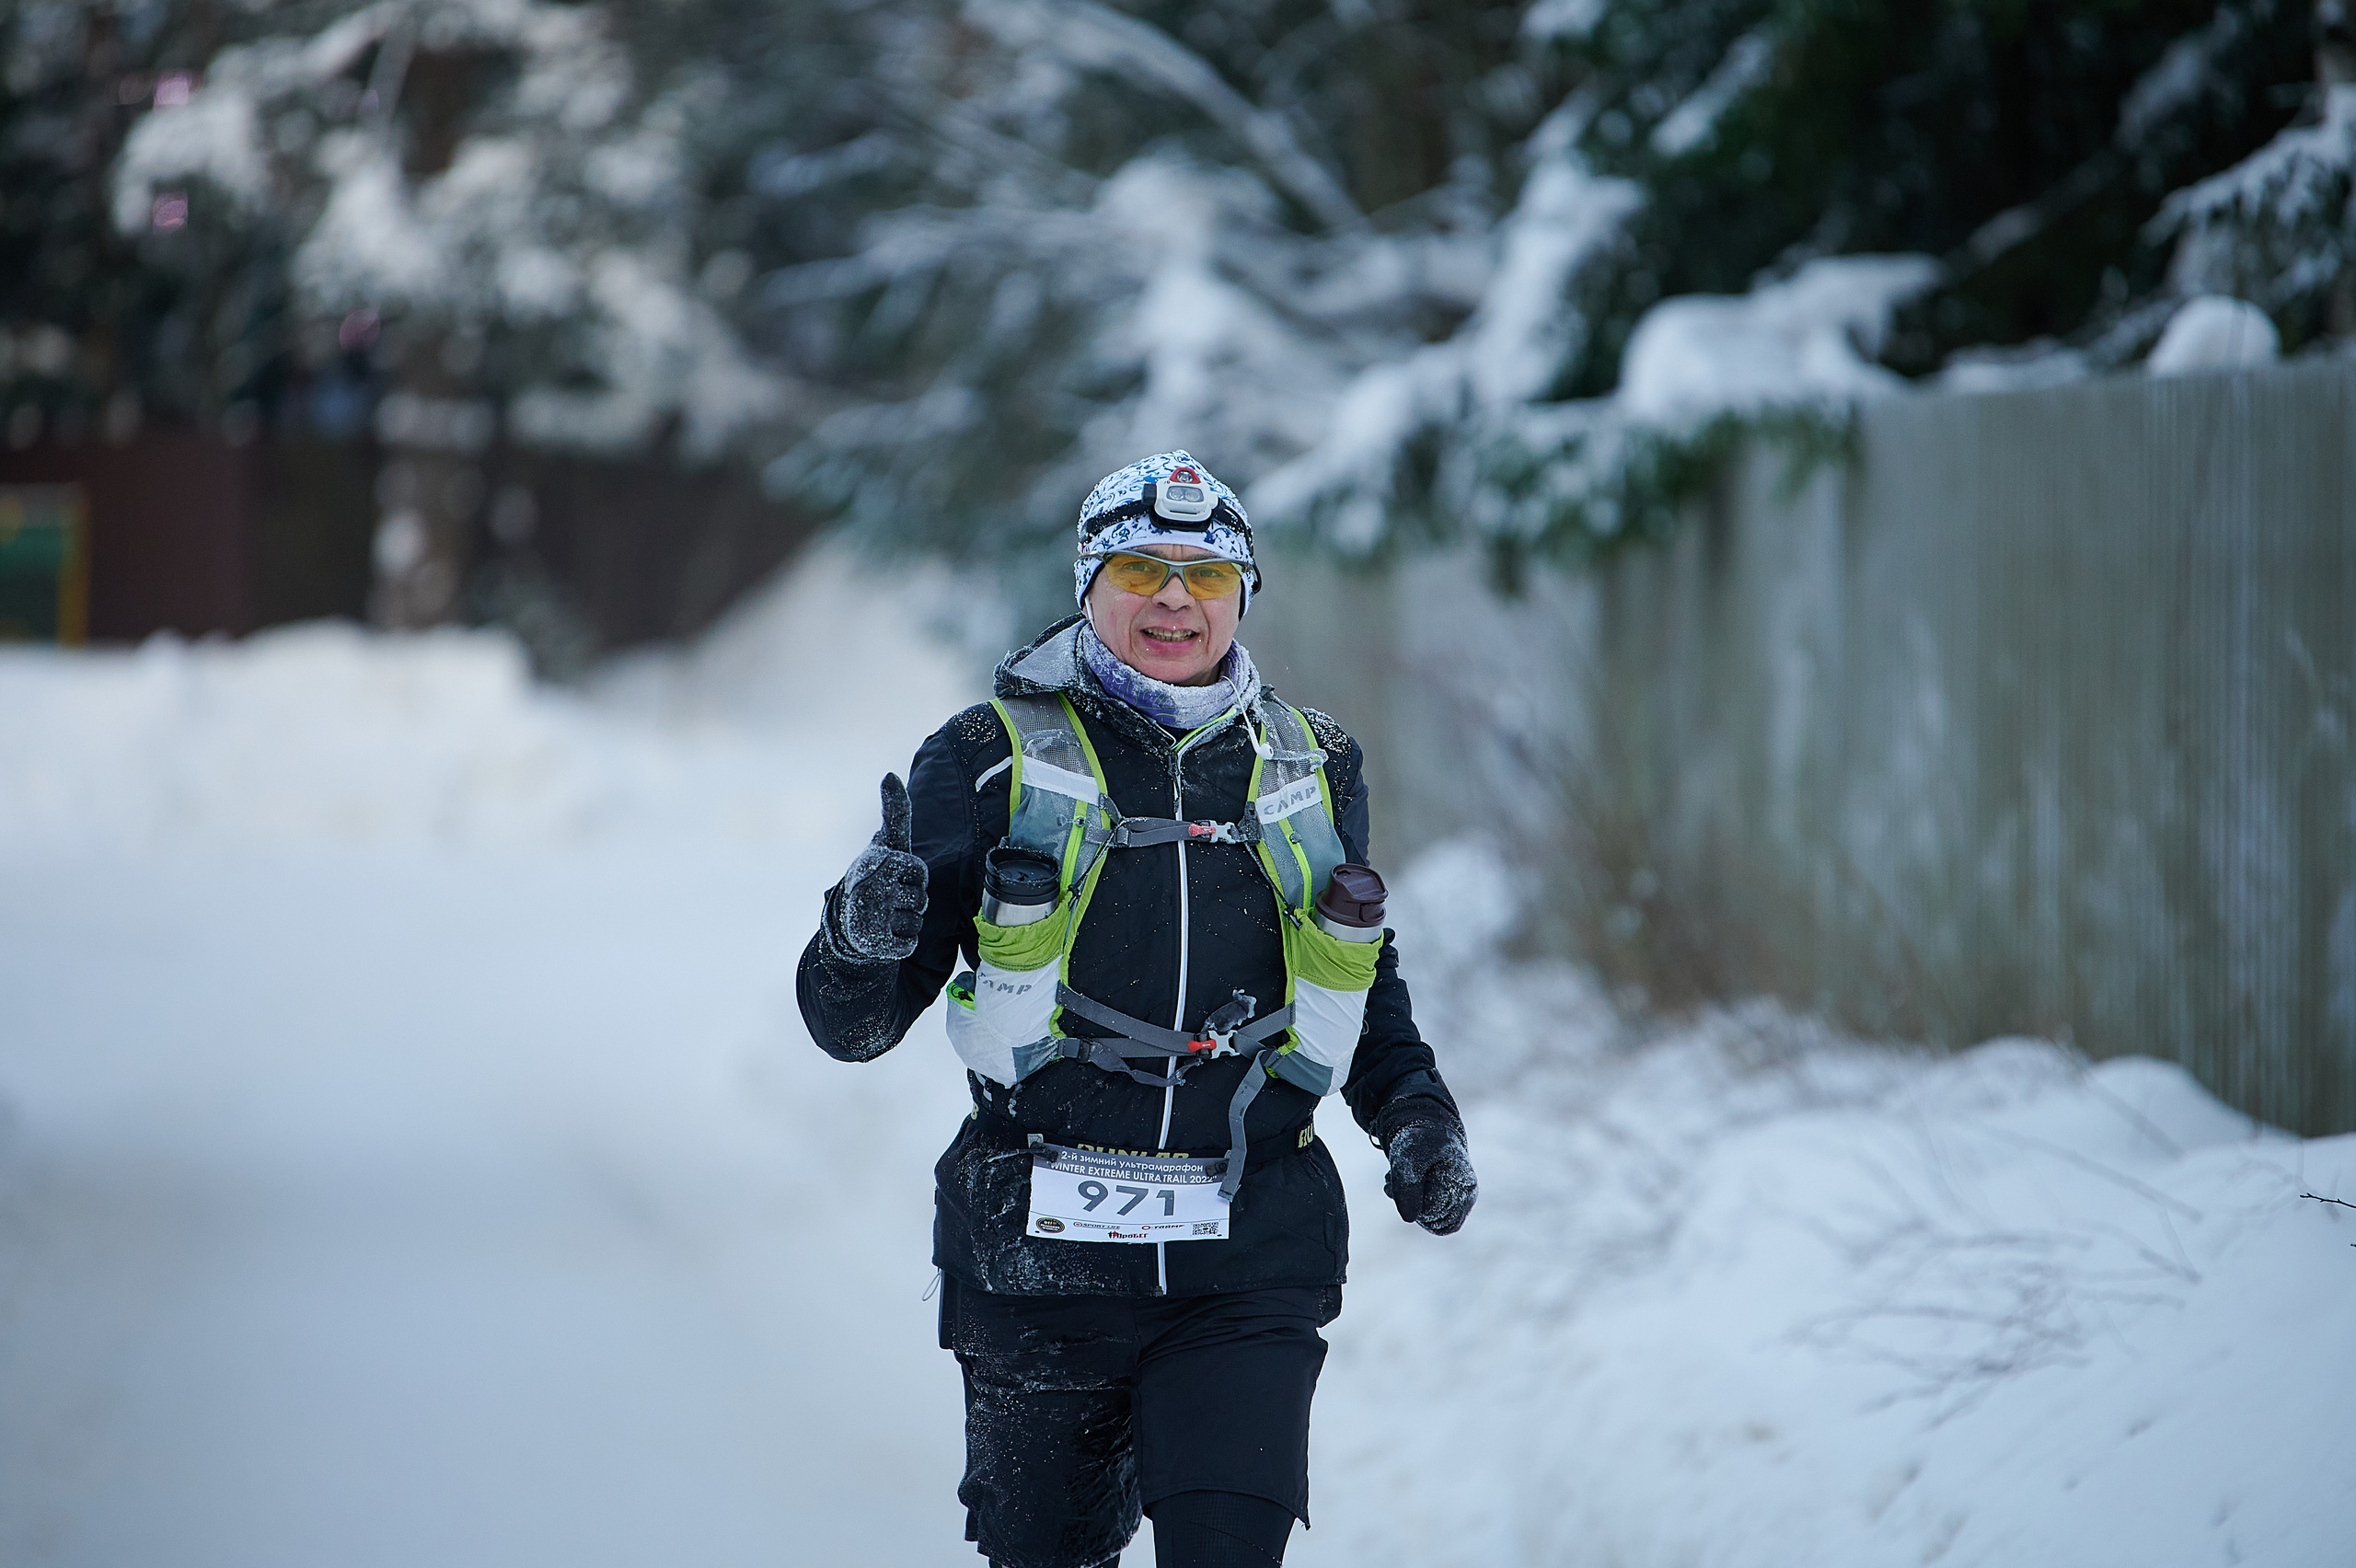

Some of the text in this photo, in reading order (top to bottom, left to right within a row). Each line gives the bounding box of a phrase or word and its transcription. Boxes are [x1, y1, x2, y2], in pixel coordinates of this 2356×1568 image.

[1263, 786, 1317, 815] CAMP
[1060, 1150, 1078, 1161] 2-й
[1080, 1154, 1116, 1166] зимний
[1119, 1160, 1203, 1173] ультрамарафон
[1088, 1166, 1131, 1180] EXTREME
[1133, 1171, 1161, 1182] ULTRA
[1162, 1174, 1187, 1183] TRAIL
[1077, 1180, 1175, 1216] 971
